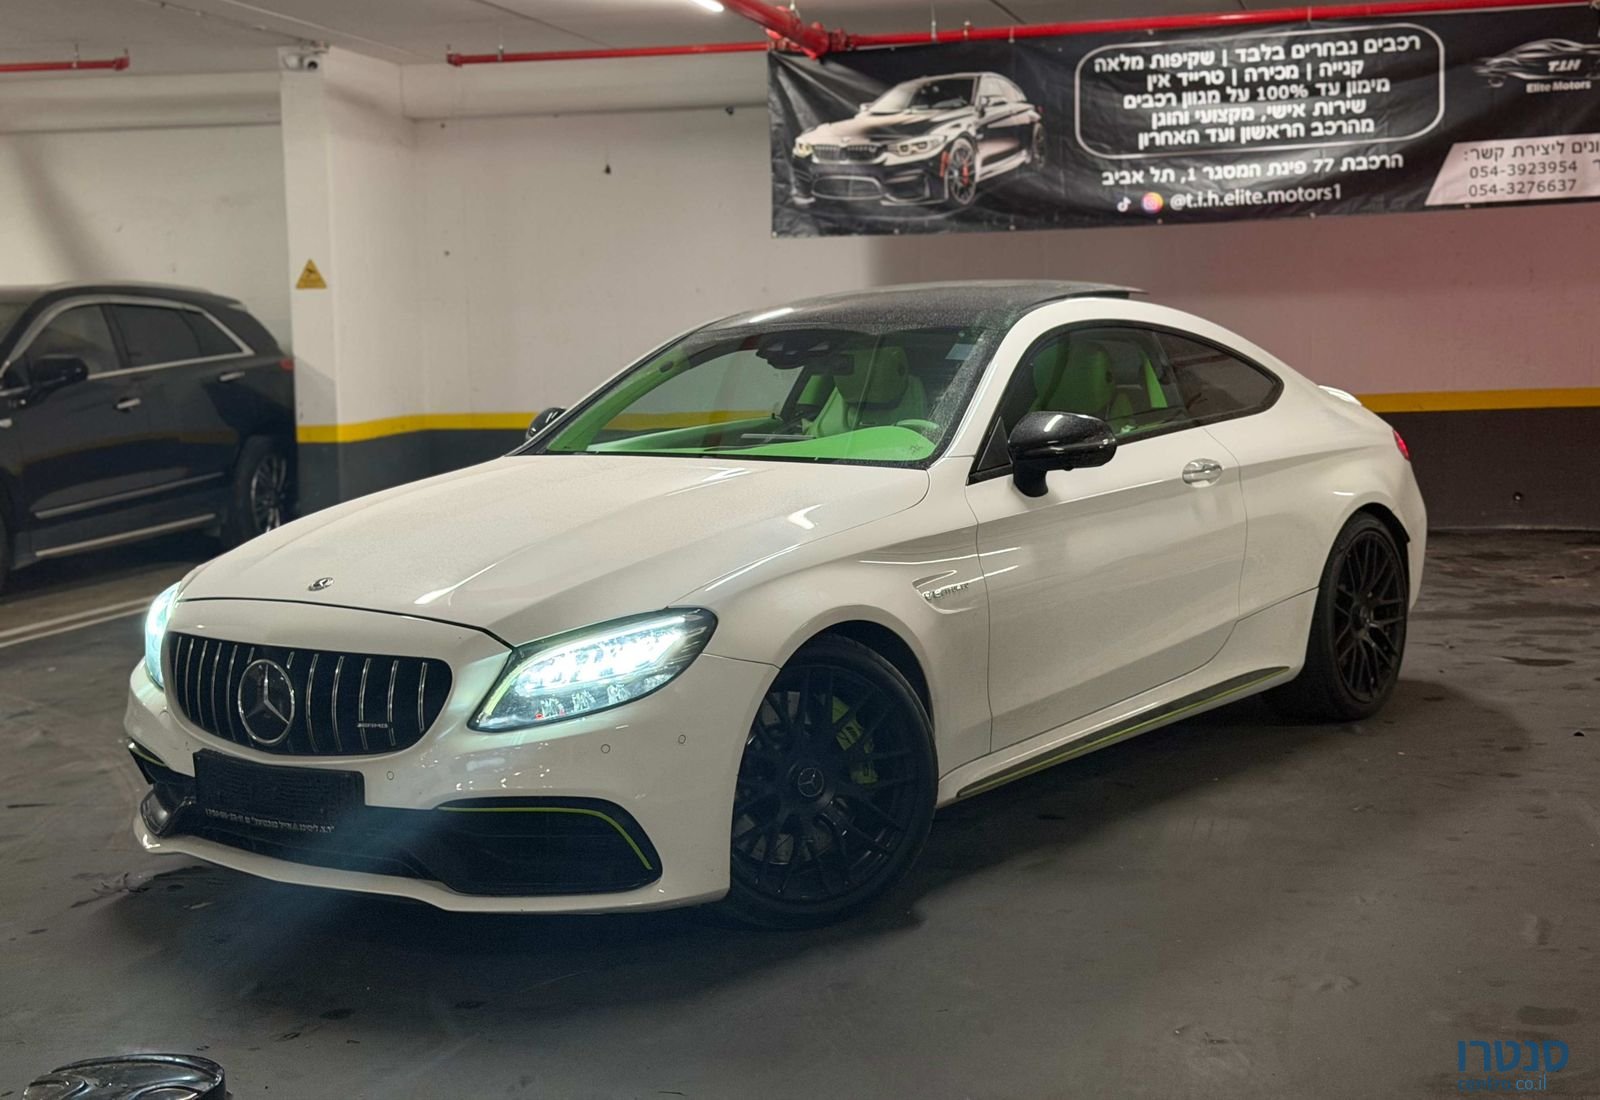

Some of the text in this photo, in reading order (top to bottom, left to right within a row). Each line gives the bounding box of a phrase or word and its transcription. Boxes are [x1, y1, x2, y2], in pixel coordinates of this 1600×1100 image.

[1234, 43, 1285, 63] בלבד
[1291, 39, 1359, 60] נבחרים
[1363, 35, 1421, 54] רכבים
[1094, 53, 1145, 72] מלאה
[1149, 50, 1216, 70] שקיפות
[1319, 60, 1364, 78] קנייה
[1146, 73, 1171, 92] אין
[1176, 70, 1225, 87] טרייד
[1244, 64, 1299, 82] מכירה
[1123, 77, 1391, 110] מימון עד 100% על מגוון רכבים
[1551, 80, 1592, 91] Motors
[1151, 98, 1367, 130] שירות אישי, מקצועי והוגן
[1138, 117, 1375, 150] מהרכב הראשון ועד האחרון
[1463, 146, 1505, 162] קשר:
[1512, 140, 1565, 158] ליצירת
[1202, 163, 1262, 181] המסגר
[1266, 160, 1308, 177] פינת
[1312, 158, 1335, 174] 77
[1340, 153, 1404, 172] הרכבת
[1468, 160, 1578, 179] 054-3923954
[1101, 169, 1145, 186] אביב
[1150, 166, 1176, 183] תל
[1169, 183, 1342, 211] @t.i.h.elite.motors1
[1468, 178, 1578, 198] 054-3276637
